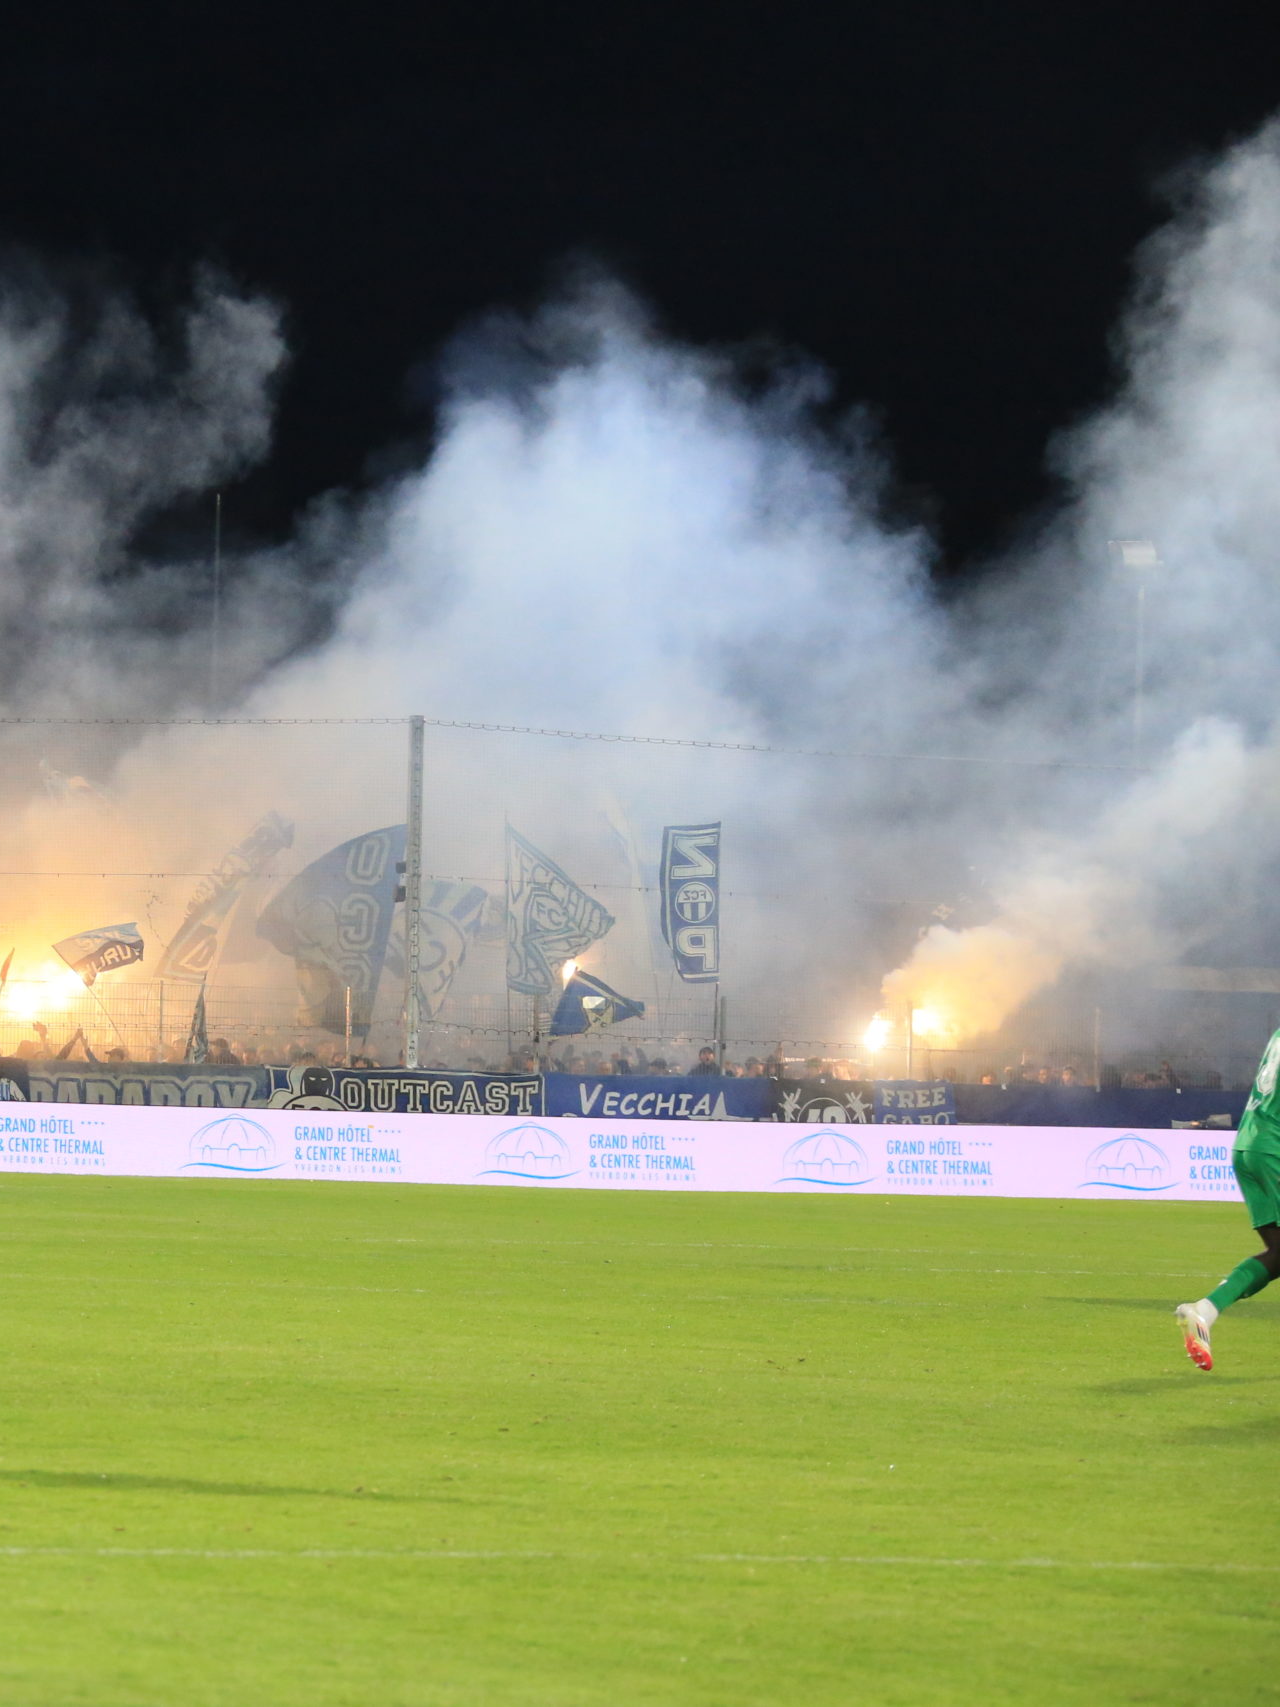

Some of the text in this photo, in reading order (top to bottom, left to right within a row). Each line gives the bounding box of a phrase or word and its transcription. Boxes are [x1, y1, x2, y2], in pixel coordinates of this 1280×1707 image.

[340, 1077, 539, 1116] OUTCAST
[882, 1087, 946, 1108] FREE
[40, 1115, 75, 1134] HÔTEL
[295, 1124, 373, 1143] GRAND HÔTEL
[8, 1137, 49, 1153] CENTRE
[54, 1138, 104, 1155] THERMAL
[589, 1132, 666, 1150] GRAND HÔTEL
[887, 1137, 963, 1155] GRAND HÔTEL
[295, 1146, 400, 1163] & CENTRE THERMAL
[589, 1154, 696, 1170] & CENTRE THERMAL
[1189, 1146, 1227, 1161] GRAND
[887, 1160, 993, 1175] & CENTRE THERMAL
[1190, 1165, 1235, 1180] & CENTR
